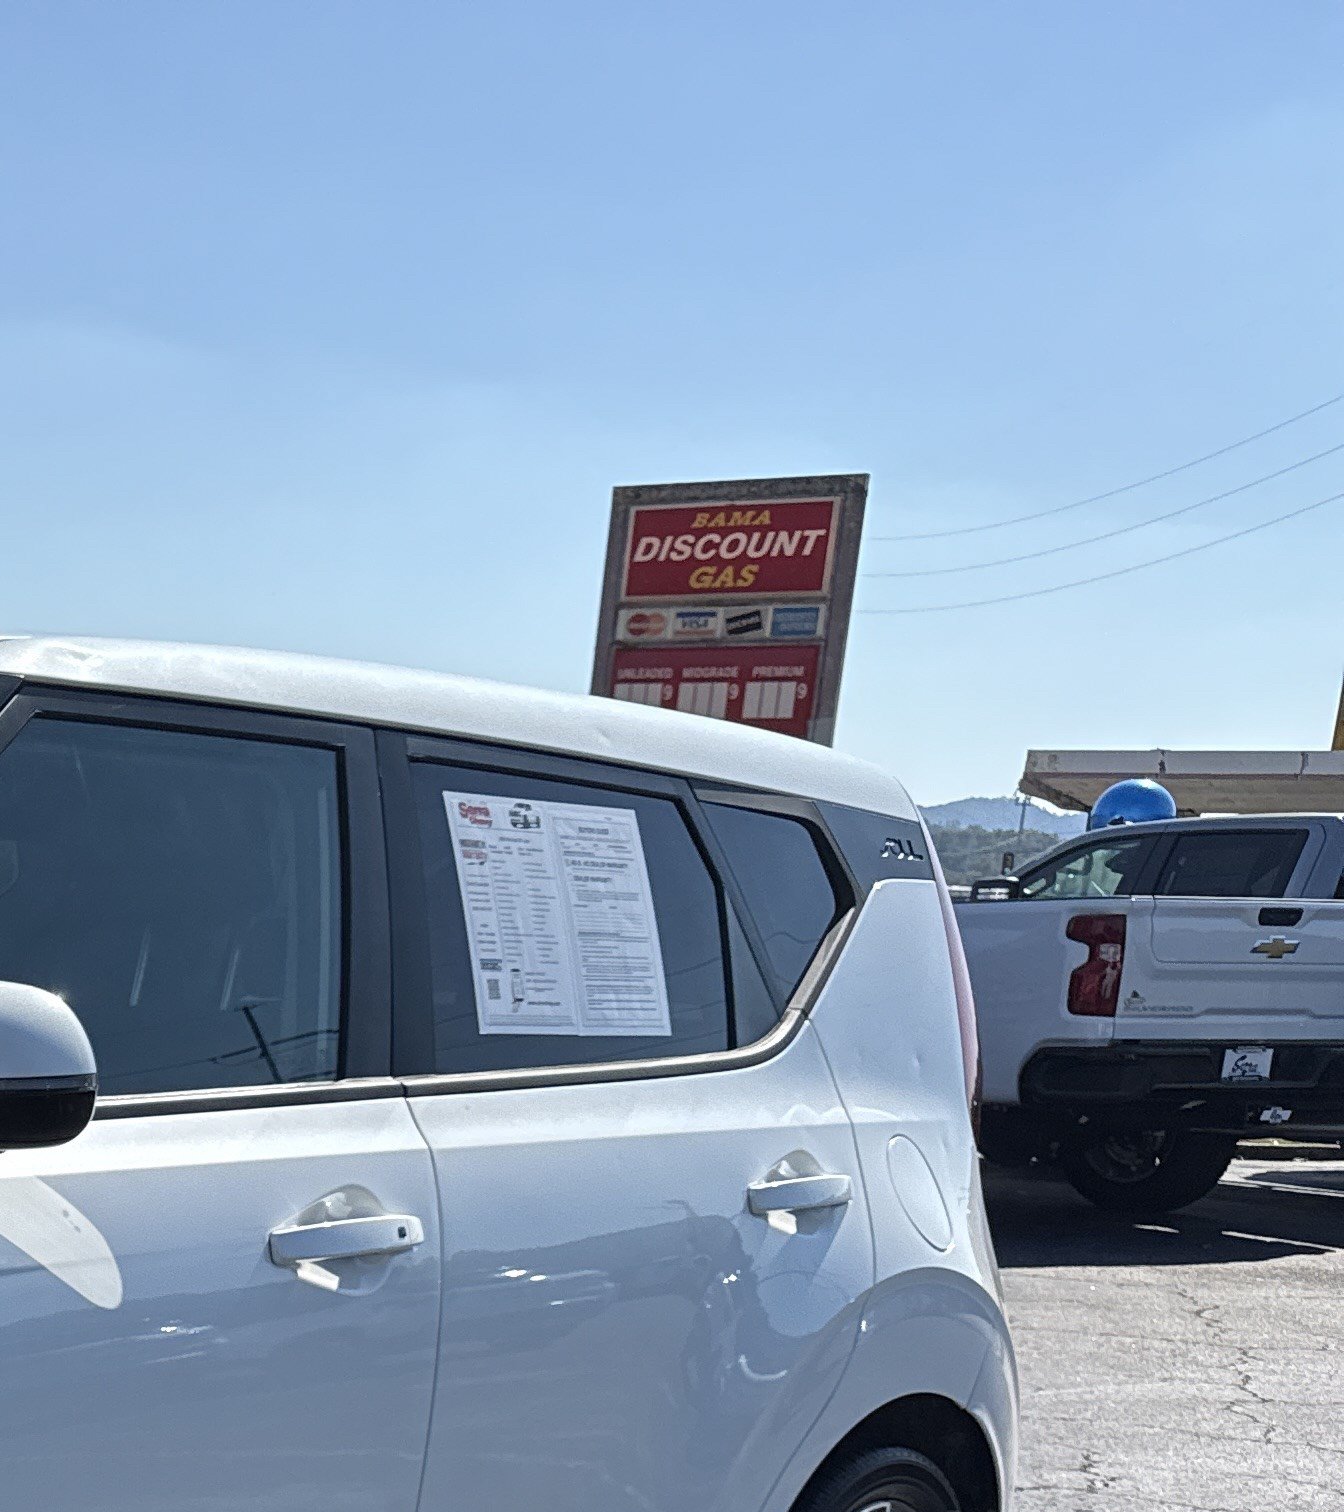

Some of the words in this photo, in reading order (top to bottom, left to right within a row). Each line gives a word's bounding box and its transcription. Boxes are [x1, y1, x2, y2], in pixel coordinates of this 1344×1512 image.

[691, 510, 771, 528] BAMA
[632, 529, 826, 563] DISCOUNT
[689, 565, 759, 589] GAS
